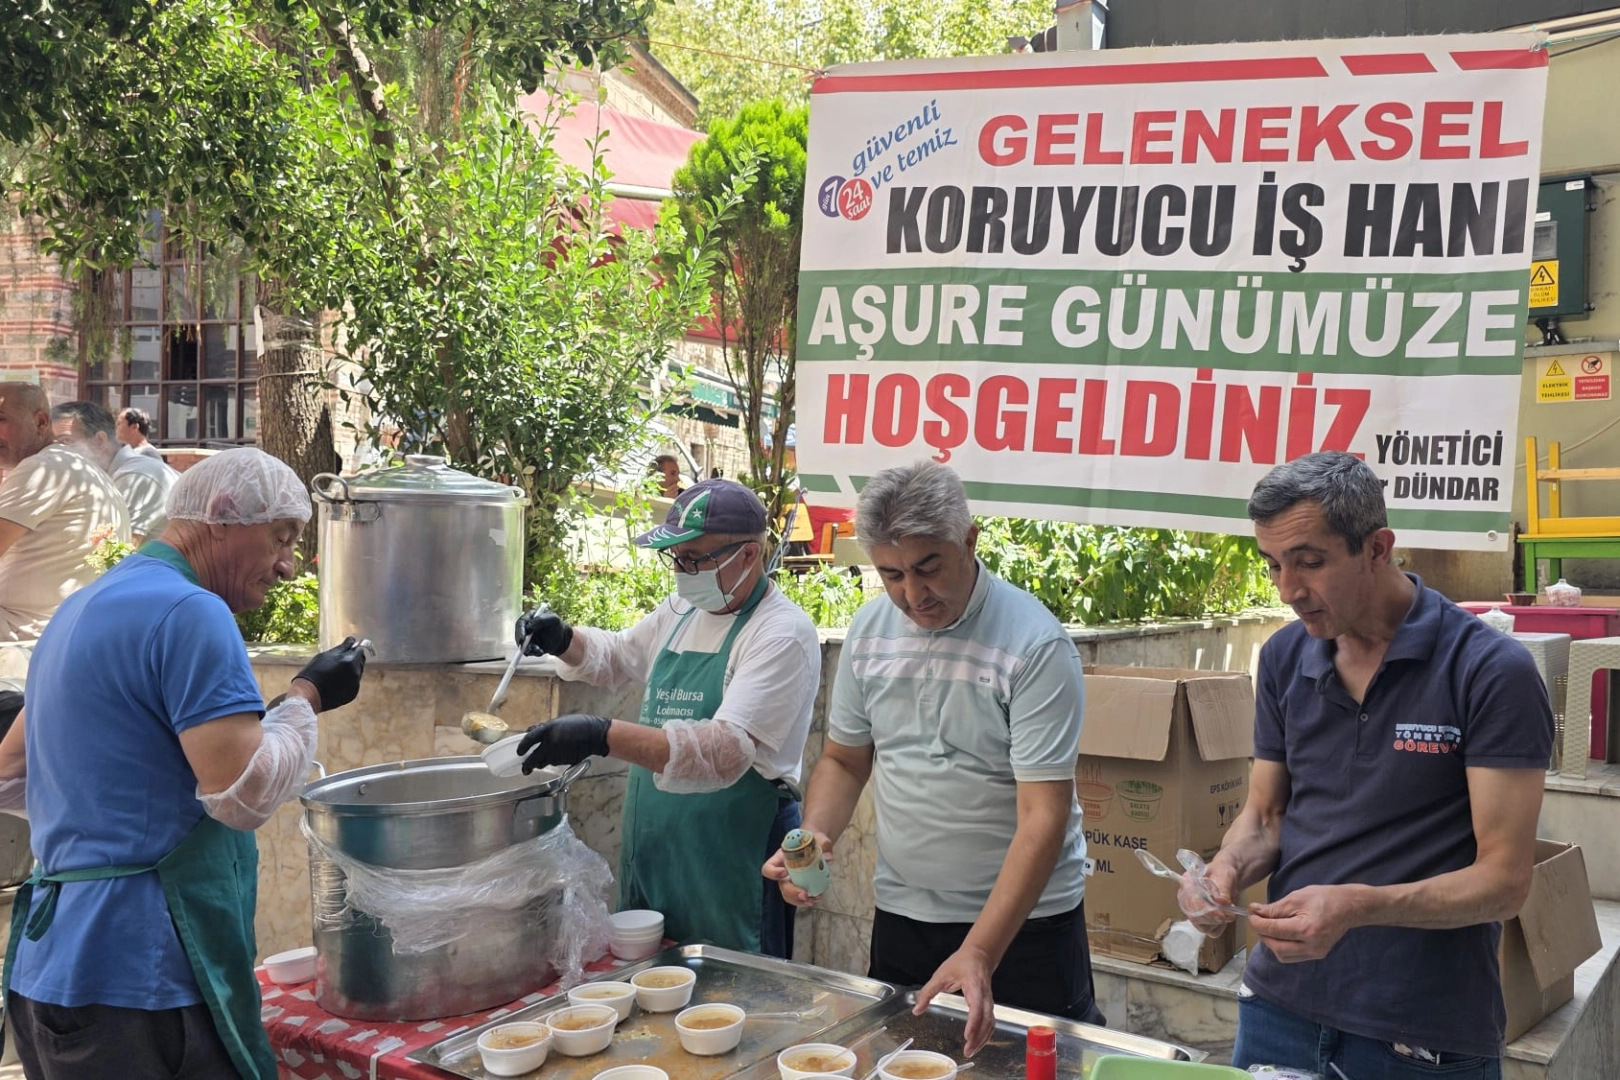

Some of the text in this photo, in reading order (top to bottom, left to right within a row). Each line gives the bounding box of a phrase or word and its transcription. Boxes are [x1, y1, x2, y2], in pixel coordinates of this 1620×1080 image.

[853, 99, 941, 177] güvenli
[978, 101, 1529, 166] GELENEKSEL
[871, 128, 958, 189] ve temiz
[842, 181, 864, 210] 24
[847, 195, 871, 219] saat
[886, 171, 1530, 273] KORUYUCU İŞ HANI
[807, 274, 1520, 361] AŞURE GÜNÜMÜZE
[823, 368, 1371, 463] HOŞGELDİNİZ
[1376, 430, 1503, 466] YÖNETİCİ
[1393, 472, 1500, 501] DÜNDAR
[677, 689, 704, 702] Bursa
[1393, 739, 1457, 754] GÖREV
[1084, 829, 1147, 850] PÜK KASE
[1096, 859, 1115, 873] ML
